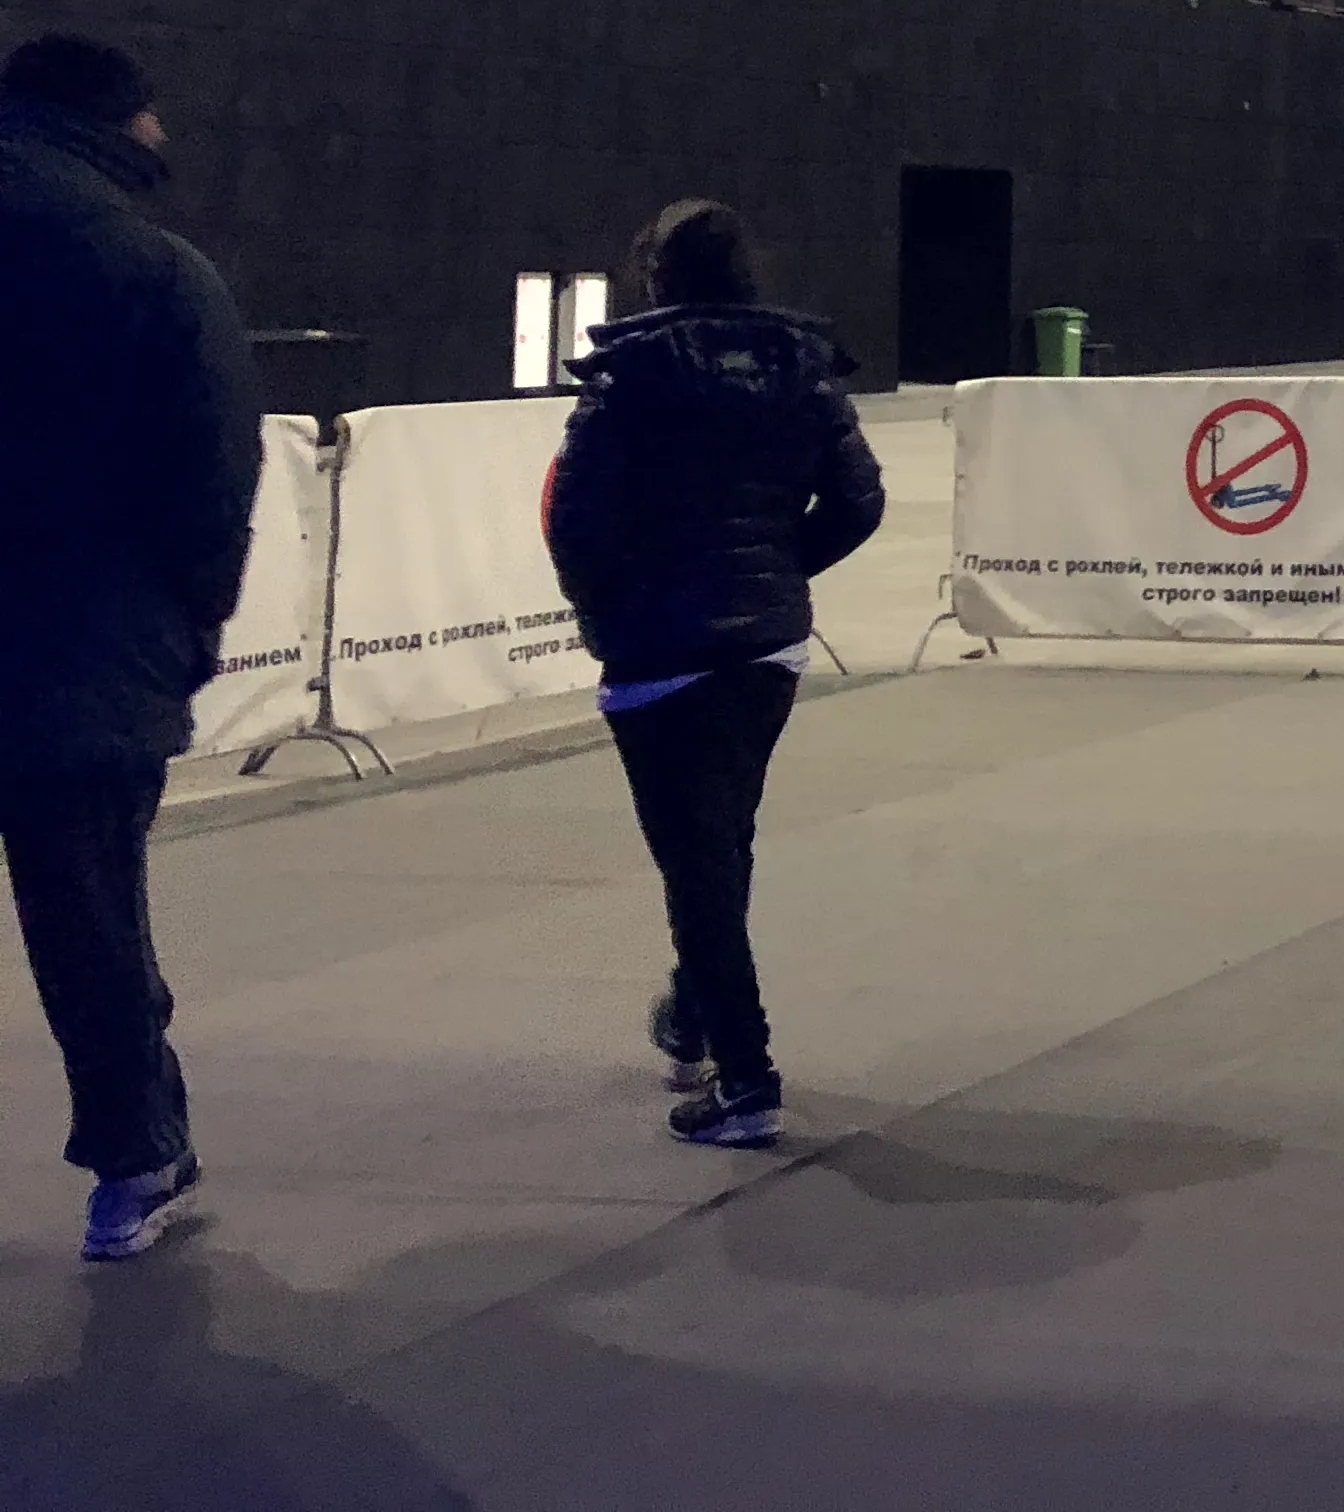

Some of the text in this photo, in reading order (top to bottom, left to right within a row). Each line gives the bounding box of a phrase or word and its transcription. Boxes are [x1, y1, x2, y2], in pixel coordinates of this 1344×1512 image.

[963, 553, 1041, 576] Проход
[1047, 558, 1059, 573] с
[1065, 556, 1148, 578] рохлей,
[1156, 557, 1263, 577] тележкой
[1271, 562, 1284, 577] и
[1142, 586, 1341, 606] строго запрещен!
[340, 637, 422, 662] Проход
[428, 630, 438, 647] с
[508, 639, 560, 664] строго
